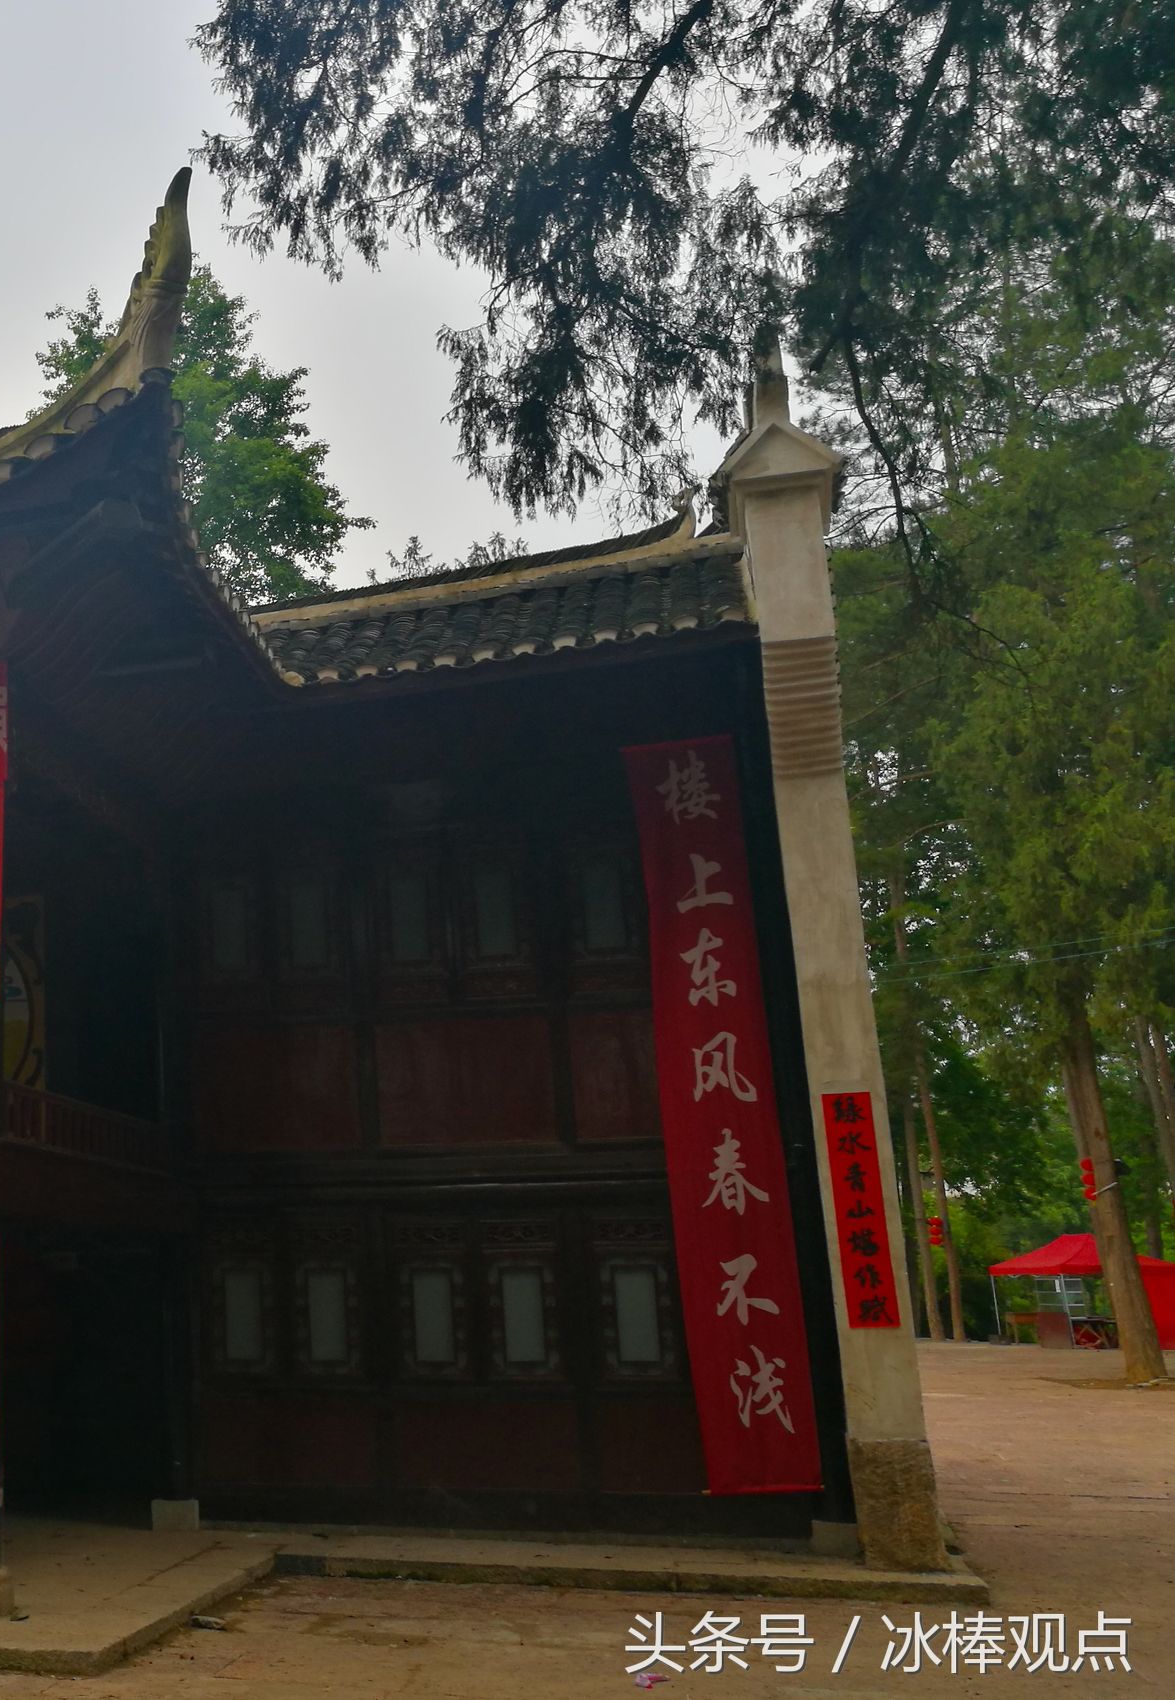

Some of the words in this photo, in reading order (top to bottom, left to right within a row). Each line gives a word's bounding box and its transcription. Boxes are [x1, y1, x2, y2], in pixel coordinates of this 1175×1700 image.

[656, 749, 797, 1434] 楼上东风春不浅
